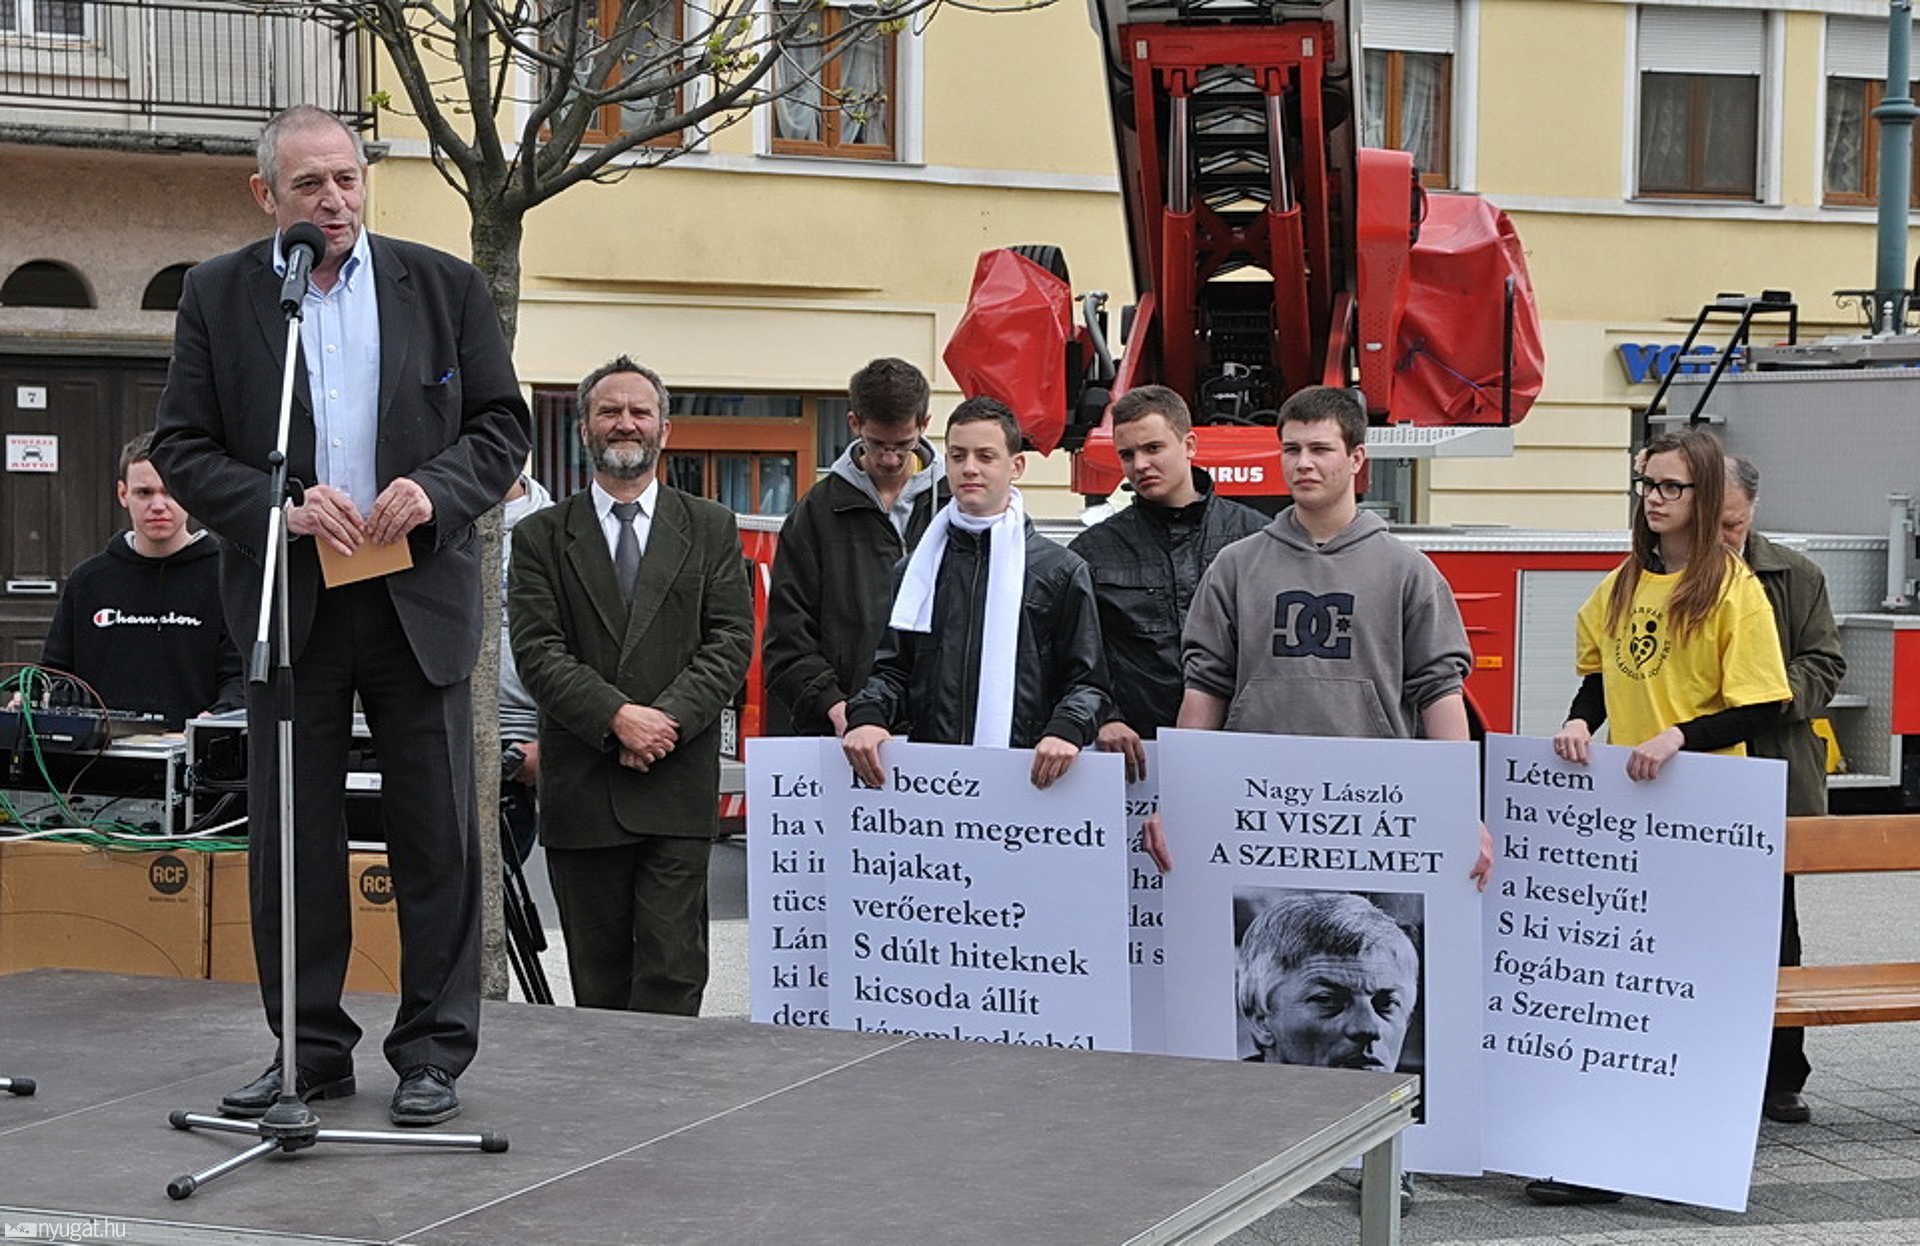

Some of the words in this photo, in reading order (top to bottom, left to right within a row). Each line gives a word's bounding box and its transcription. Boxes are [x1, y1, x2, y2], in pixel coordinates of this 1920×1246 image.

[28, 392, 36, 403] 7
[893, 767, 979, 797] becéz
[1506, 757, 1594, 791] Létem
[1245, 779, 1313, 806] Nagy
[1323, 783, 1403, 803] László
[772, 813, 805, 835] ha
[851, 806, 944, 837] falban
[955, 821, 1105, 851] megeredt
[1235, 809, 1267, 831] KI
[1277, 811, 1361, 836] VISZI
[1372, 810, 1416, 837] ÁT
[1505, 797, 1538, 823] ha
[1546, 805, 1637, 841] végleg
[1646, 813, 1773, 855] lemerűlt,
[773, 851, 798, 873] ki
[852, 848, 971, 888] hajakat,
[1209, 843, 1230, 864] A
[1239, 844, 1443, 873] SZERELMET
[1504, 835, 1528, 860] ki
[1539, 847, 1637, 872] rettenti
[153, 867, 185, 883] RCF
[773, 890, 826, 911] tücs
[1502, 881, 1515, 897] a
[1525, 876, 1646, 914] keselyűt!
[853, 896, 1025, 928] verőereket?
[773, 927, 827, 949] Lán
[1499, 911, 1513, 935] S
[1523, 915, 1548, 939] ki
[1558, 921, 1619, 948] viszi
[1630, 929, 1656, 953] át
[855, 933, 870, 959] S
[881, 936, 939, 965] dúlt
[950, 942, 1088, 975] hiteknek
[1153, 945, 1164, 965] s
[773, 965, 798, 988] ki
[1494, 950, 1604, 986] fogában
[1616, 972, 1694, 998] tartva
[855, 976, 971, 1009] kicsoda
[982, 987, 1039, 1014] állít
[1488, 996, 1502, 1011] a
[1512, 992, 1649, 1033] Szerelmet
[1483, 1034, 1496, 1049] a
[1508, 1033, 1572, 1060] túlsó
[1581, 1048, 1677, 1076] partra!
